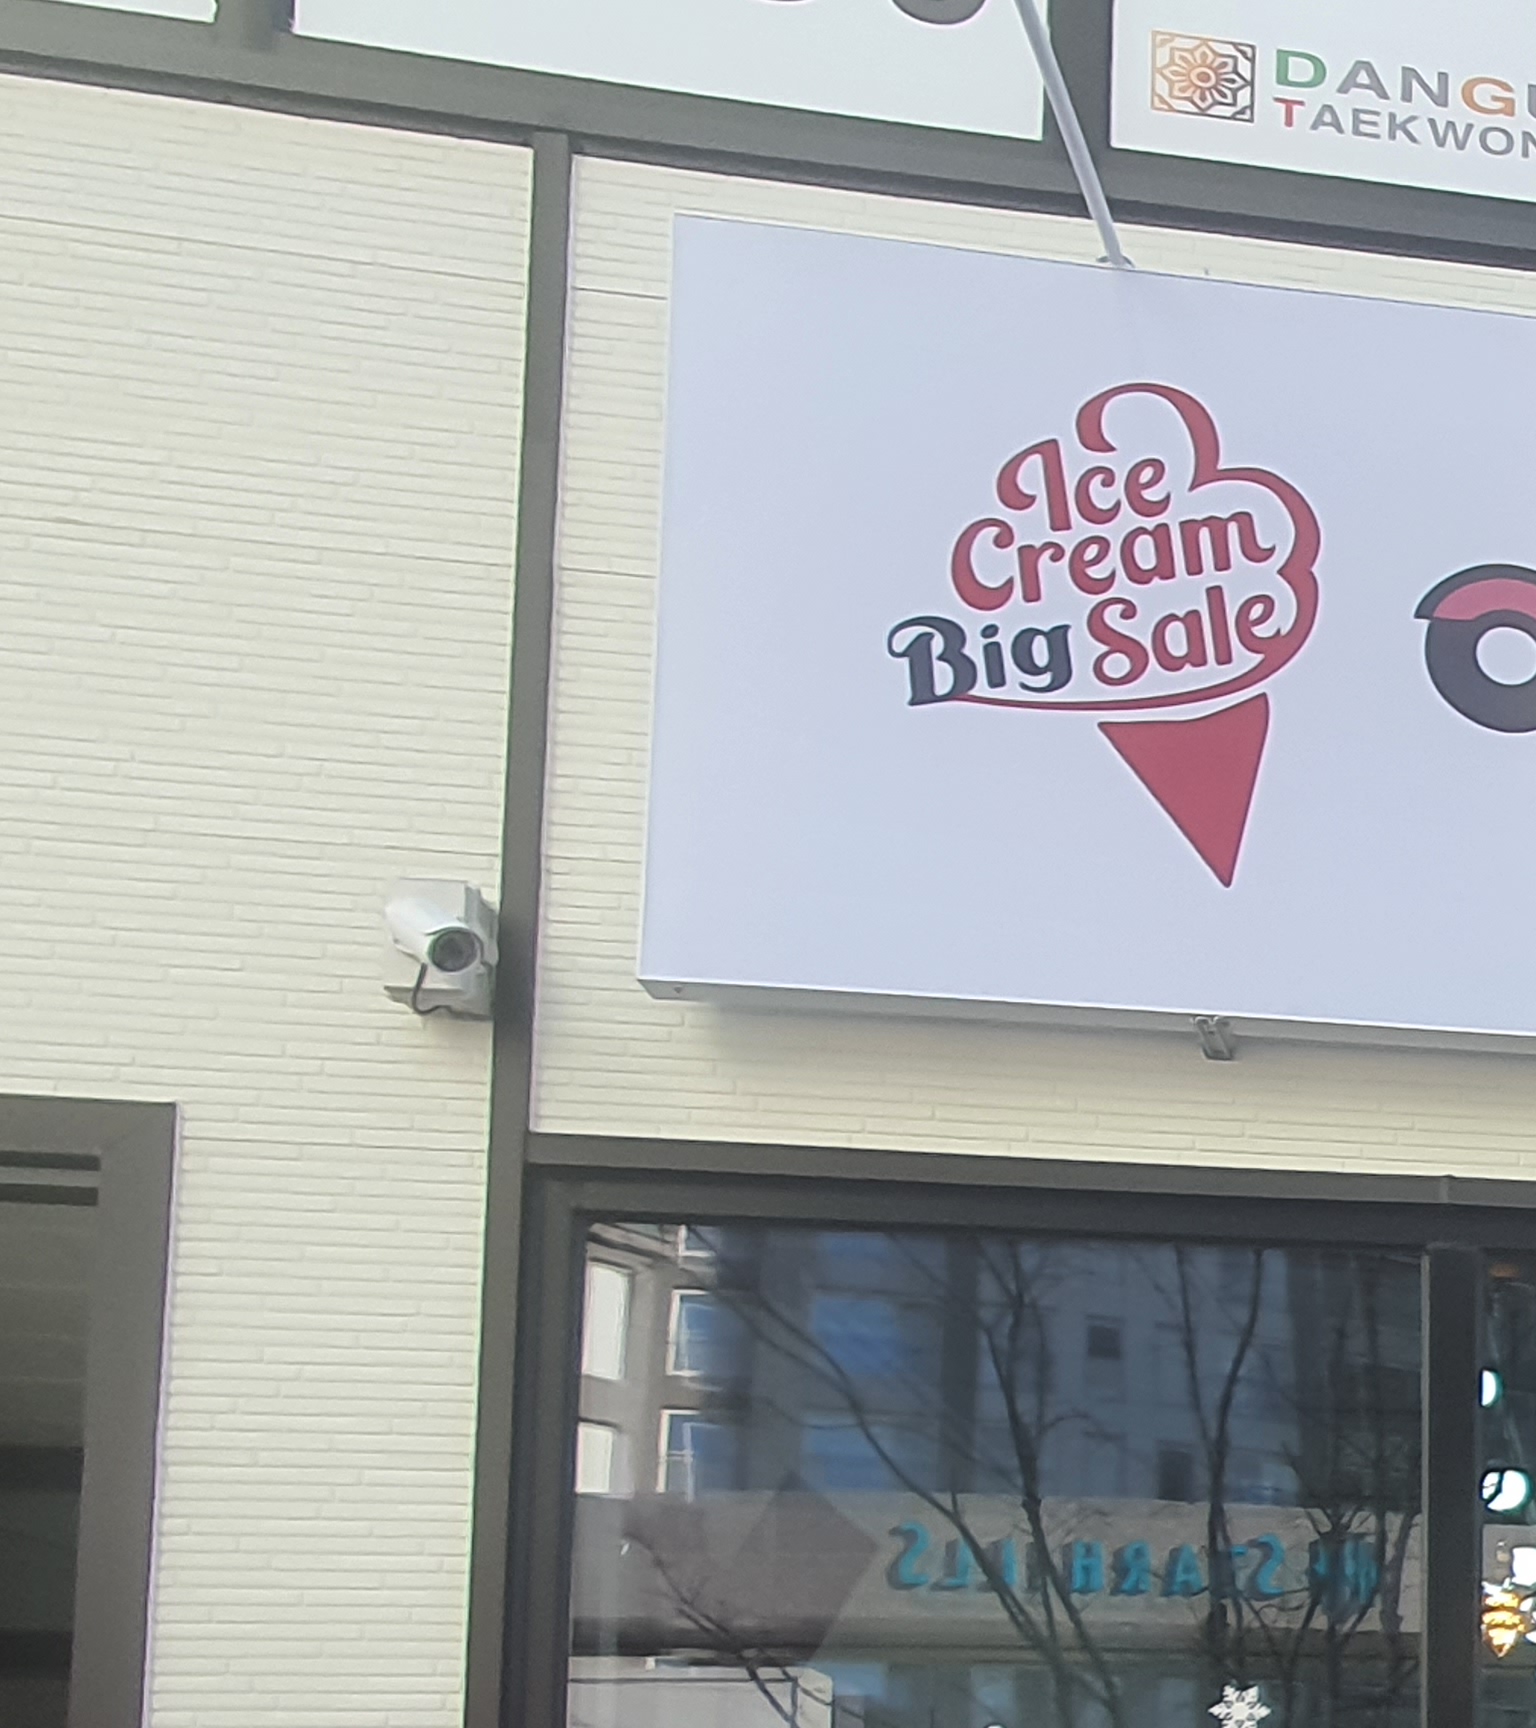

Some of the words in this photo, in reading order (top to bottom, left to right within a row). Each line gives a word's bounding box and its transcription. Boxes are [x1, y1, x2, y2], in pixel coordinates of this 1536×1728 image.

[996, 437, 1171, 532] Ice
[950, 511, 1276, 611] Cream
[887, 615, 1073, 706] Big
[1086, 585, 1281, 686] Sale
